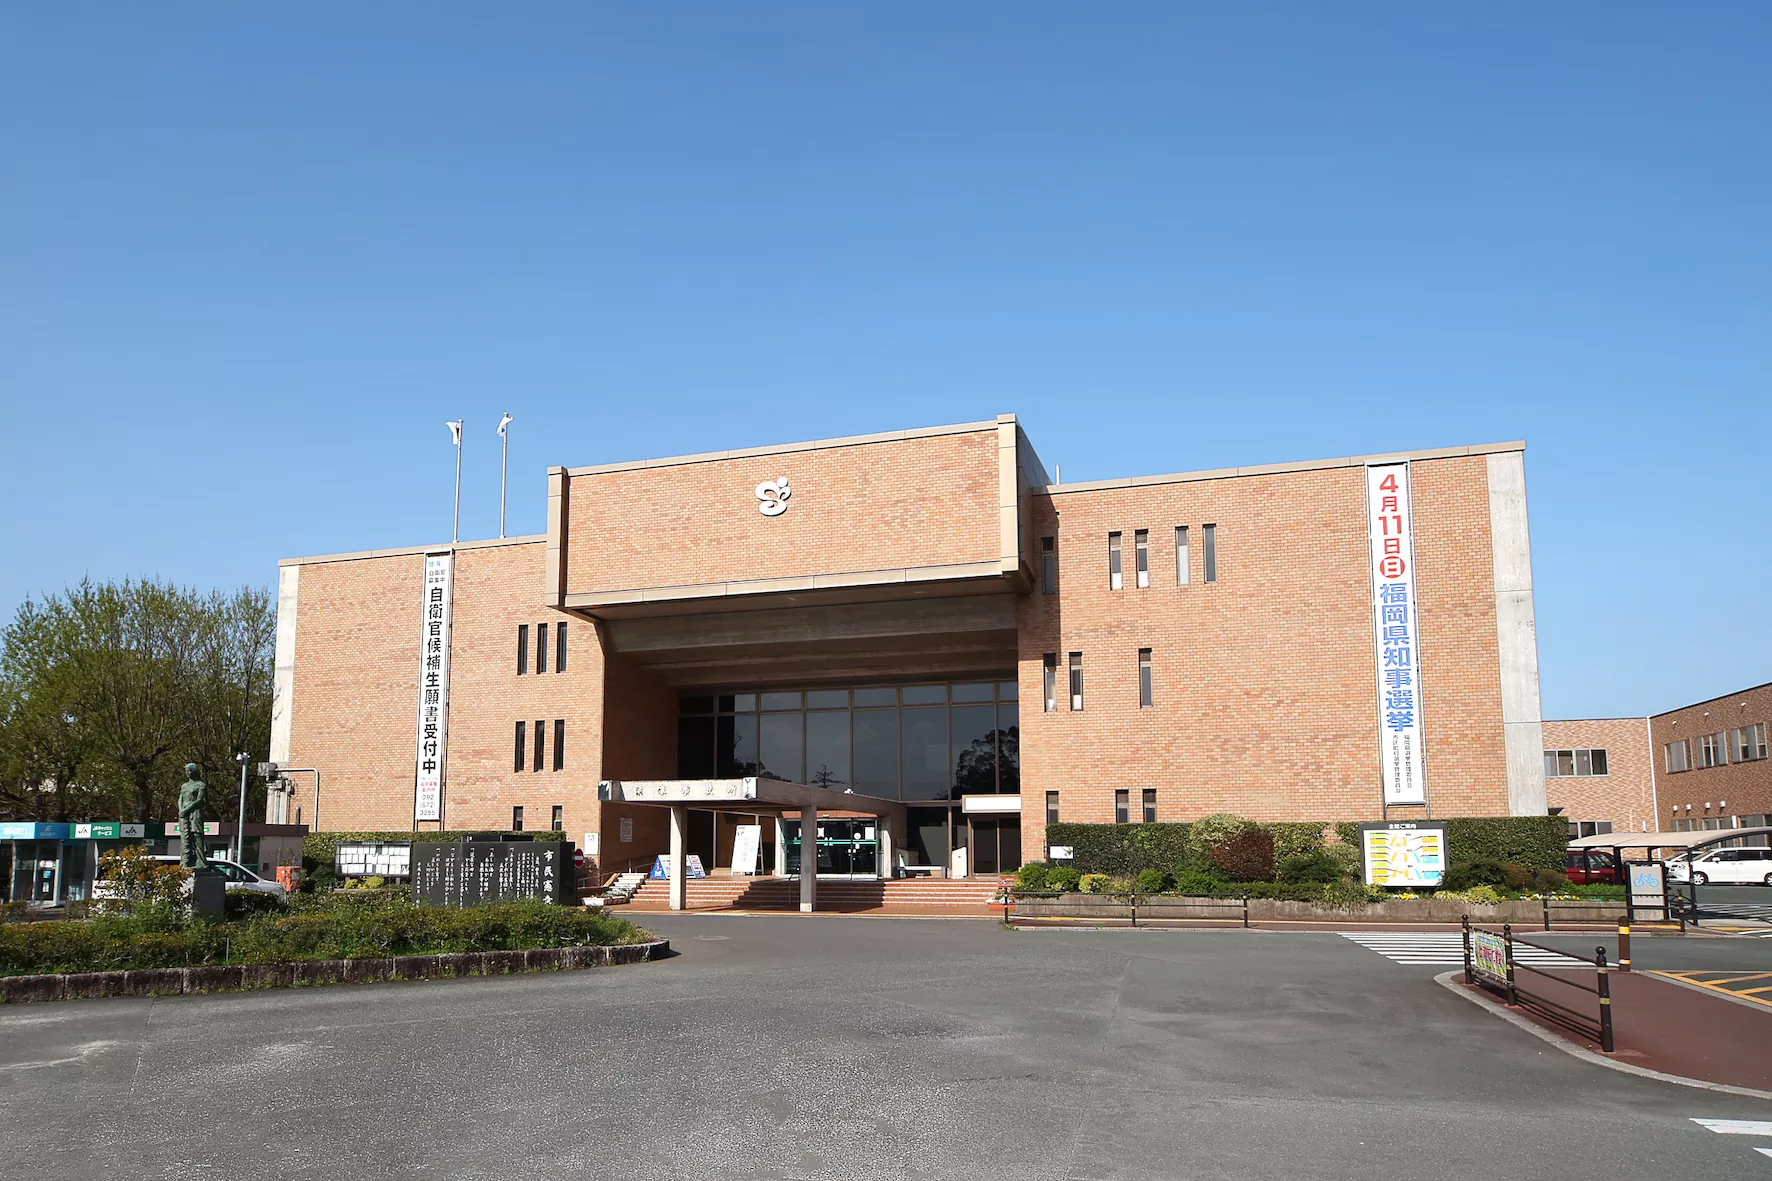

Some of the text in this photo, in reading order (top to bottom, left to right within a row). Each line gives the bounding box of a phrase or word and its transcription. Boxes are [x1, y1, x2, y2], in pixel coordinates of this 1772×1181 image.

[423, 587, 443, 774] 自衛官候補生願書受付中
[1379, 582, 1414, 732] 福岡県知事選挙
